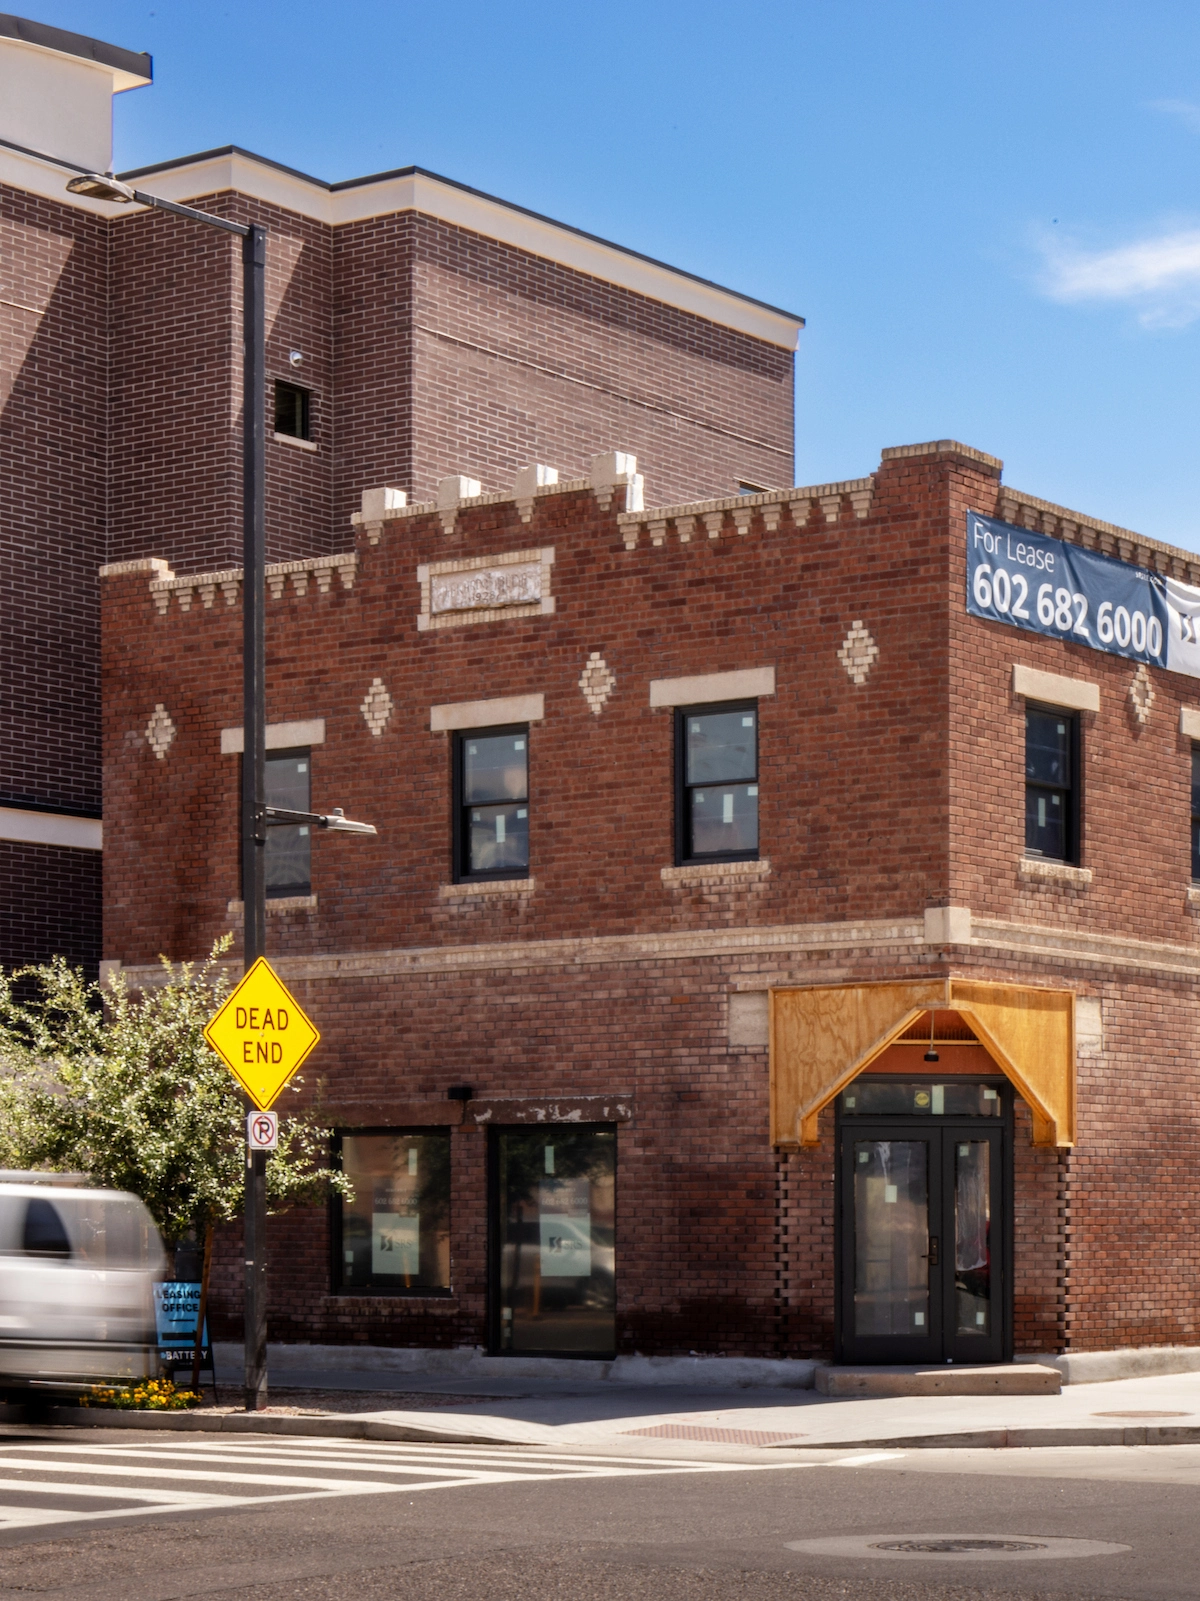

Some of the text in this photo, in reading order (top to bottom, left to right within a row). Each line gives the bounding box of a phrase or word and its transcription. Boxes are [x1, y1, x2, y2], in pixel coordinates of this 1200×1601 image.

[973, 521, 1055, 573] For Lease
[973, 563, 1163, 657] 602 682 6000
[235, 1006, 289, 1031] DEAD
[243, 1041, 283, 1064] END
[157, 1290, 201, 1299] LEASING
[162, 1303, 200, 1313] OFFICE
[165, 1350, 208, 1361] BATTEY
